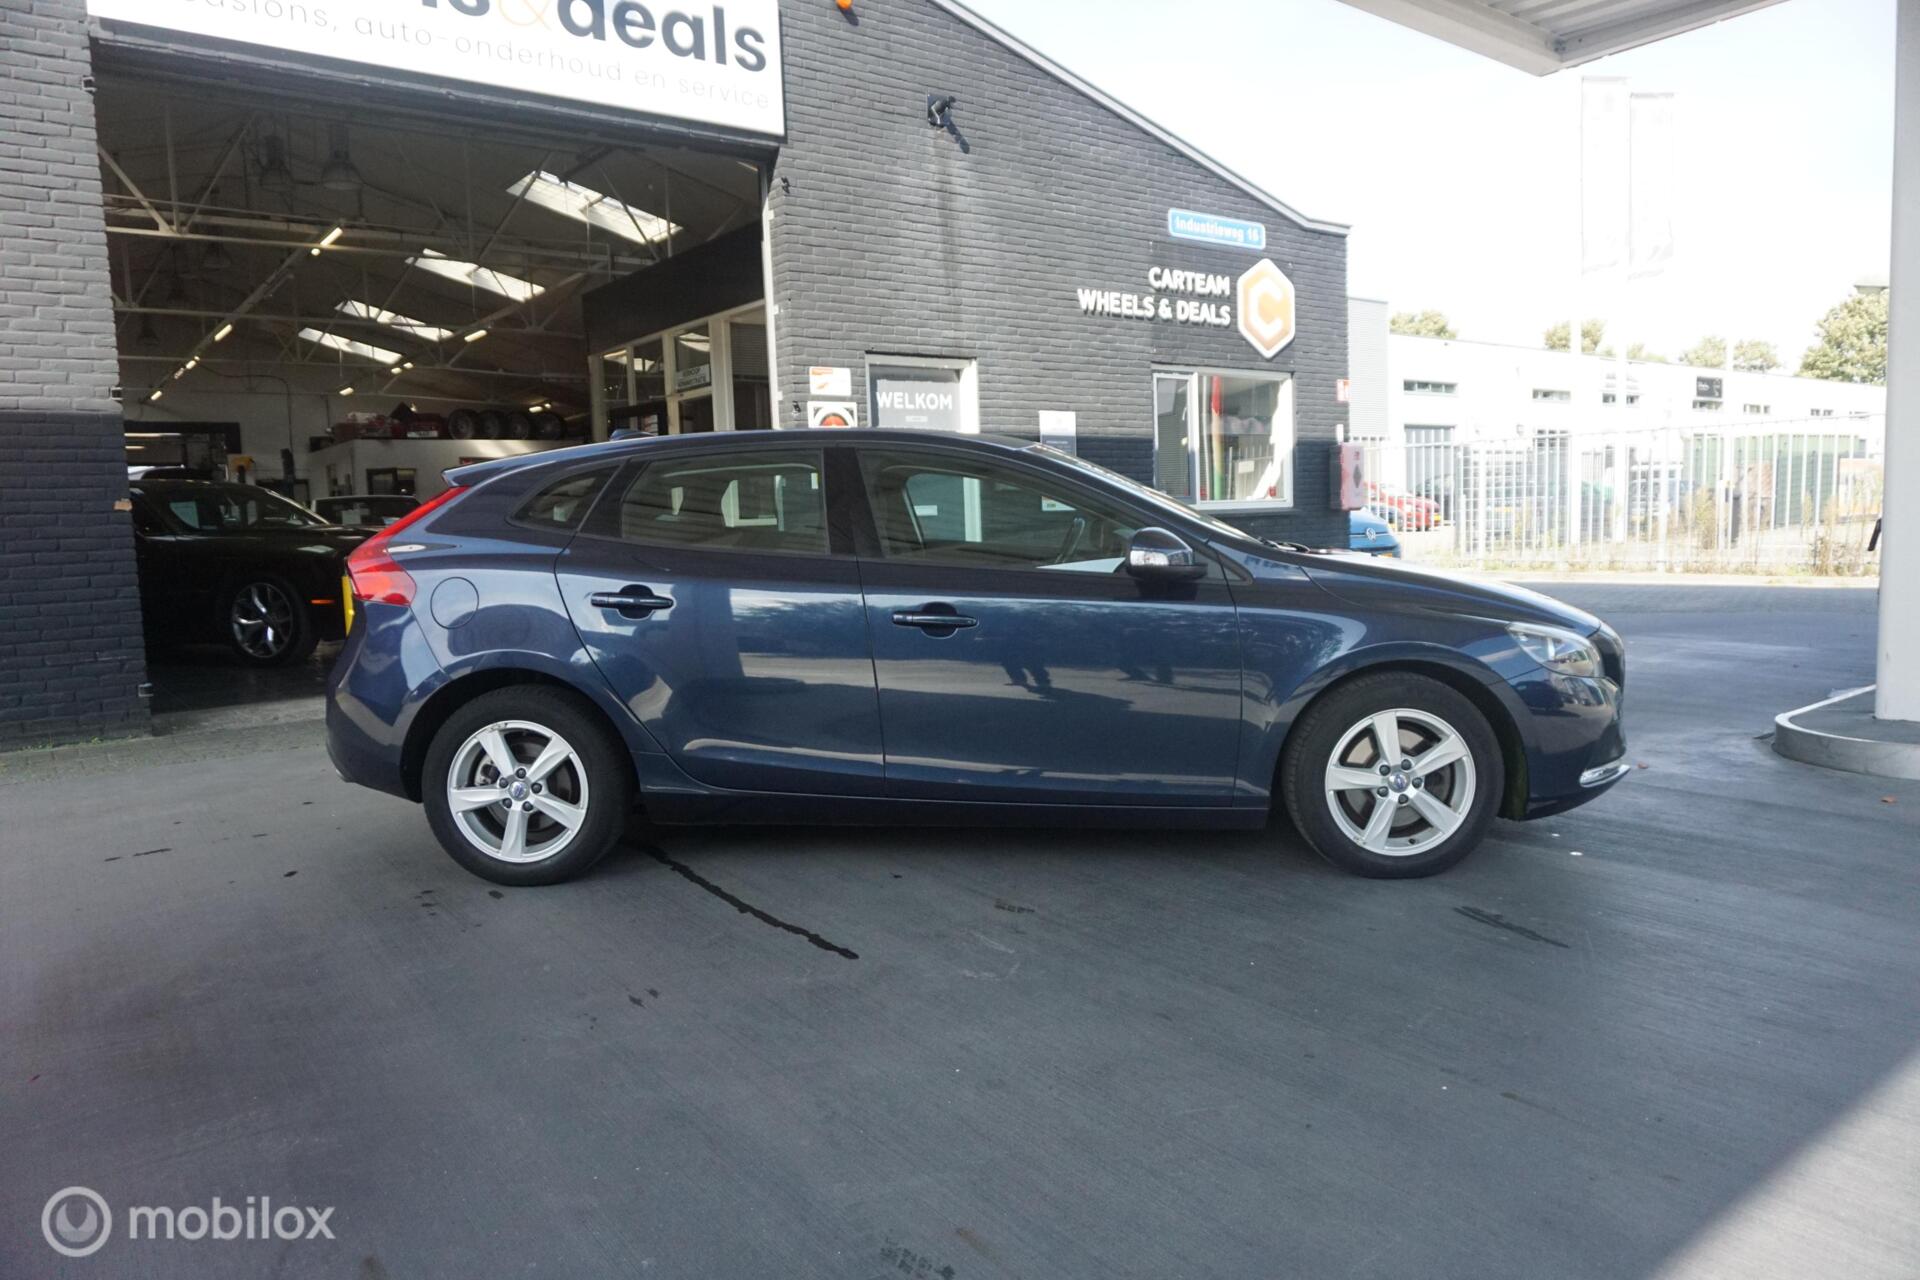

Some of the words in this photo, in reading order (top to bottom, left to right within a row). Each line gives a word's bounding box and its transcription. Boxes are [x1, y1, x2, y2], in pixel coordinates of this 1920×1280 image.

[184, 0, 337, 32] sions,
[353, 17, 622, 82] auto-onderhoud
[634, 68, 667, 90] en
[678, 77, 771, 110] service
[1175, 214, 1244, 242] Industrieweg
[1149, 266, 1231, 296] CARTEAM
[1077, 288, 1155, 318] WHEELS
[1158, 299, 1173, 320] &
[1176, 300, 1231, 326] DEALS
[876, 391, 953, 410] WELKOM
